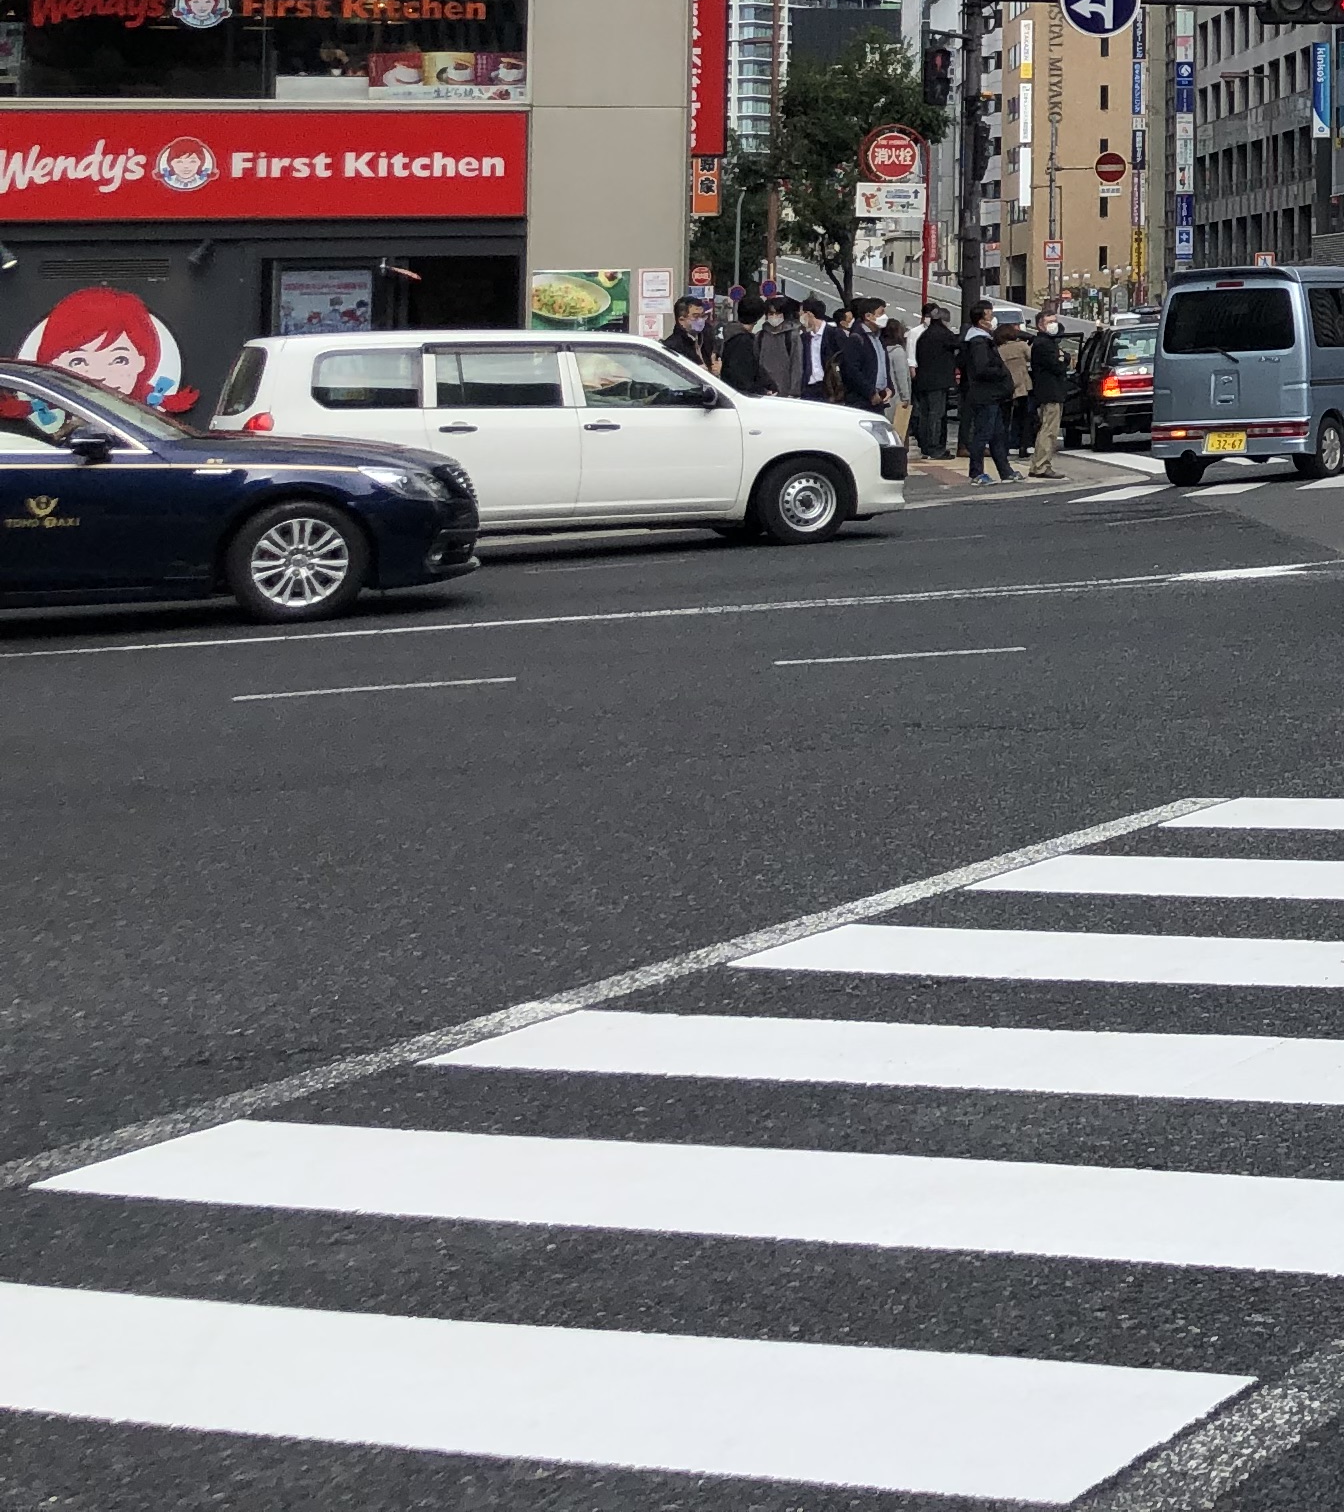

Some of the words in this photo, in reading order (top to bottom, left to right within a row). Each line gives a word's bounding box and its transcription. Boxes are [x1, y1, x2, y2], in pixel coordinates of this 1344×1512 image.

[874, 147, 914, 165] 消火栓
[0, 139, 147, 194] Wendy's
[231, 152, 333, 179] First
[344, 150, 506, 179] Kitchen
[1215, 439, 1244, 451] 32-67
